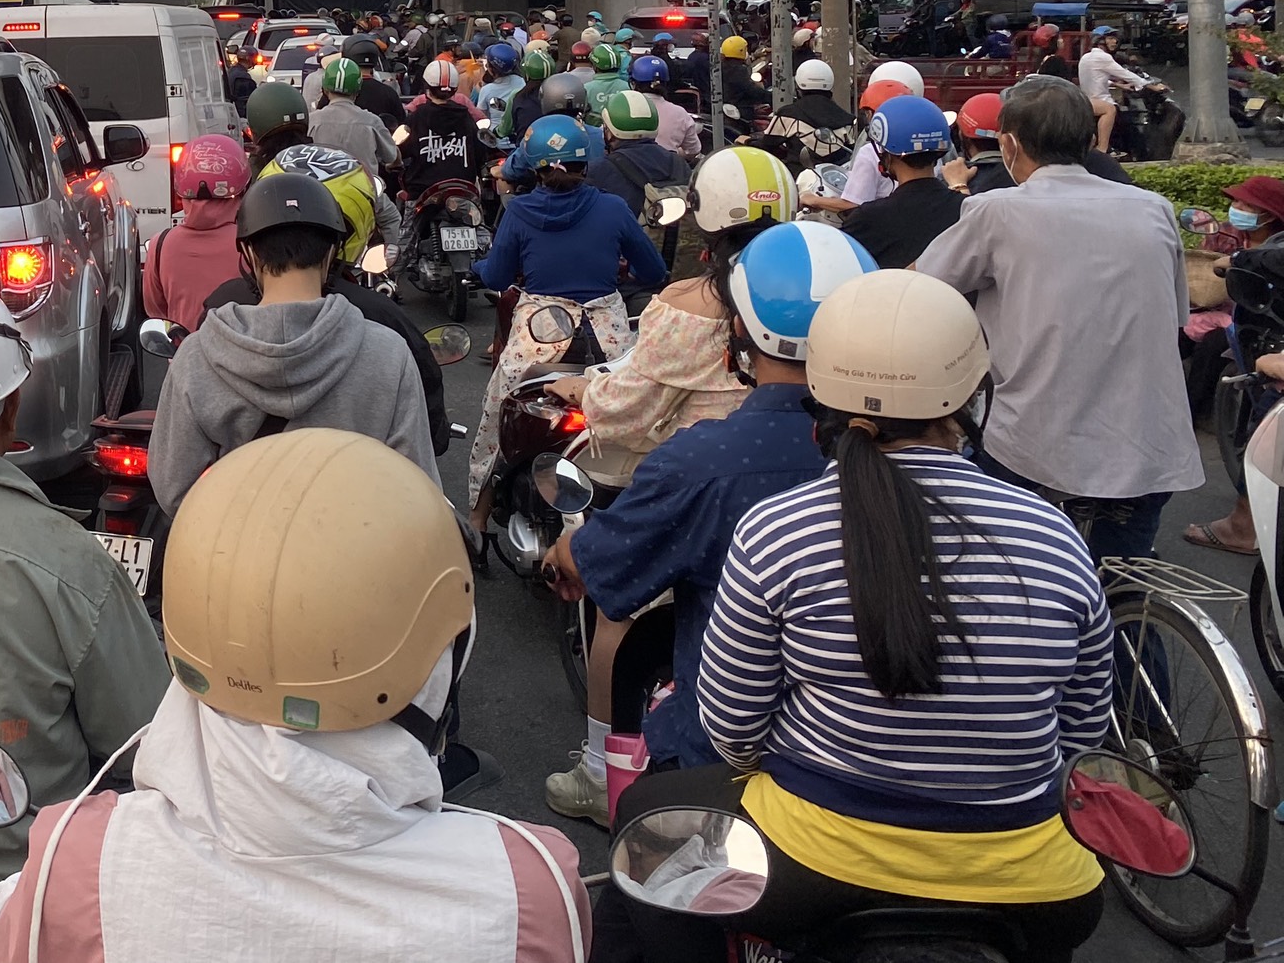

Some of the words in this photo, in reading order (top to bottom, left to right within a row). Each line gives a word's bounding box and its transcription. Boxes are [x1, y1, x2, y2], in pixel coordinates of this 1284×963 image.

[446, 229, 471, 239] 75-K1
[444, 239, 476, 250] 026.09
[866, 371, 877, 380] Trị
[878, 372, 898, 381] Vĩnh
